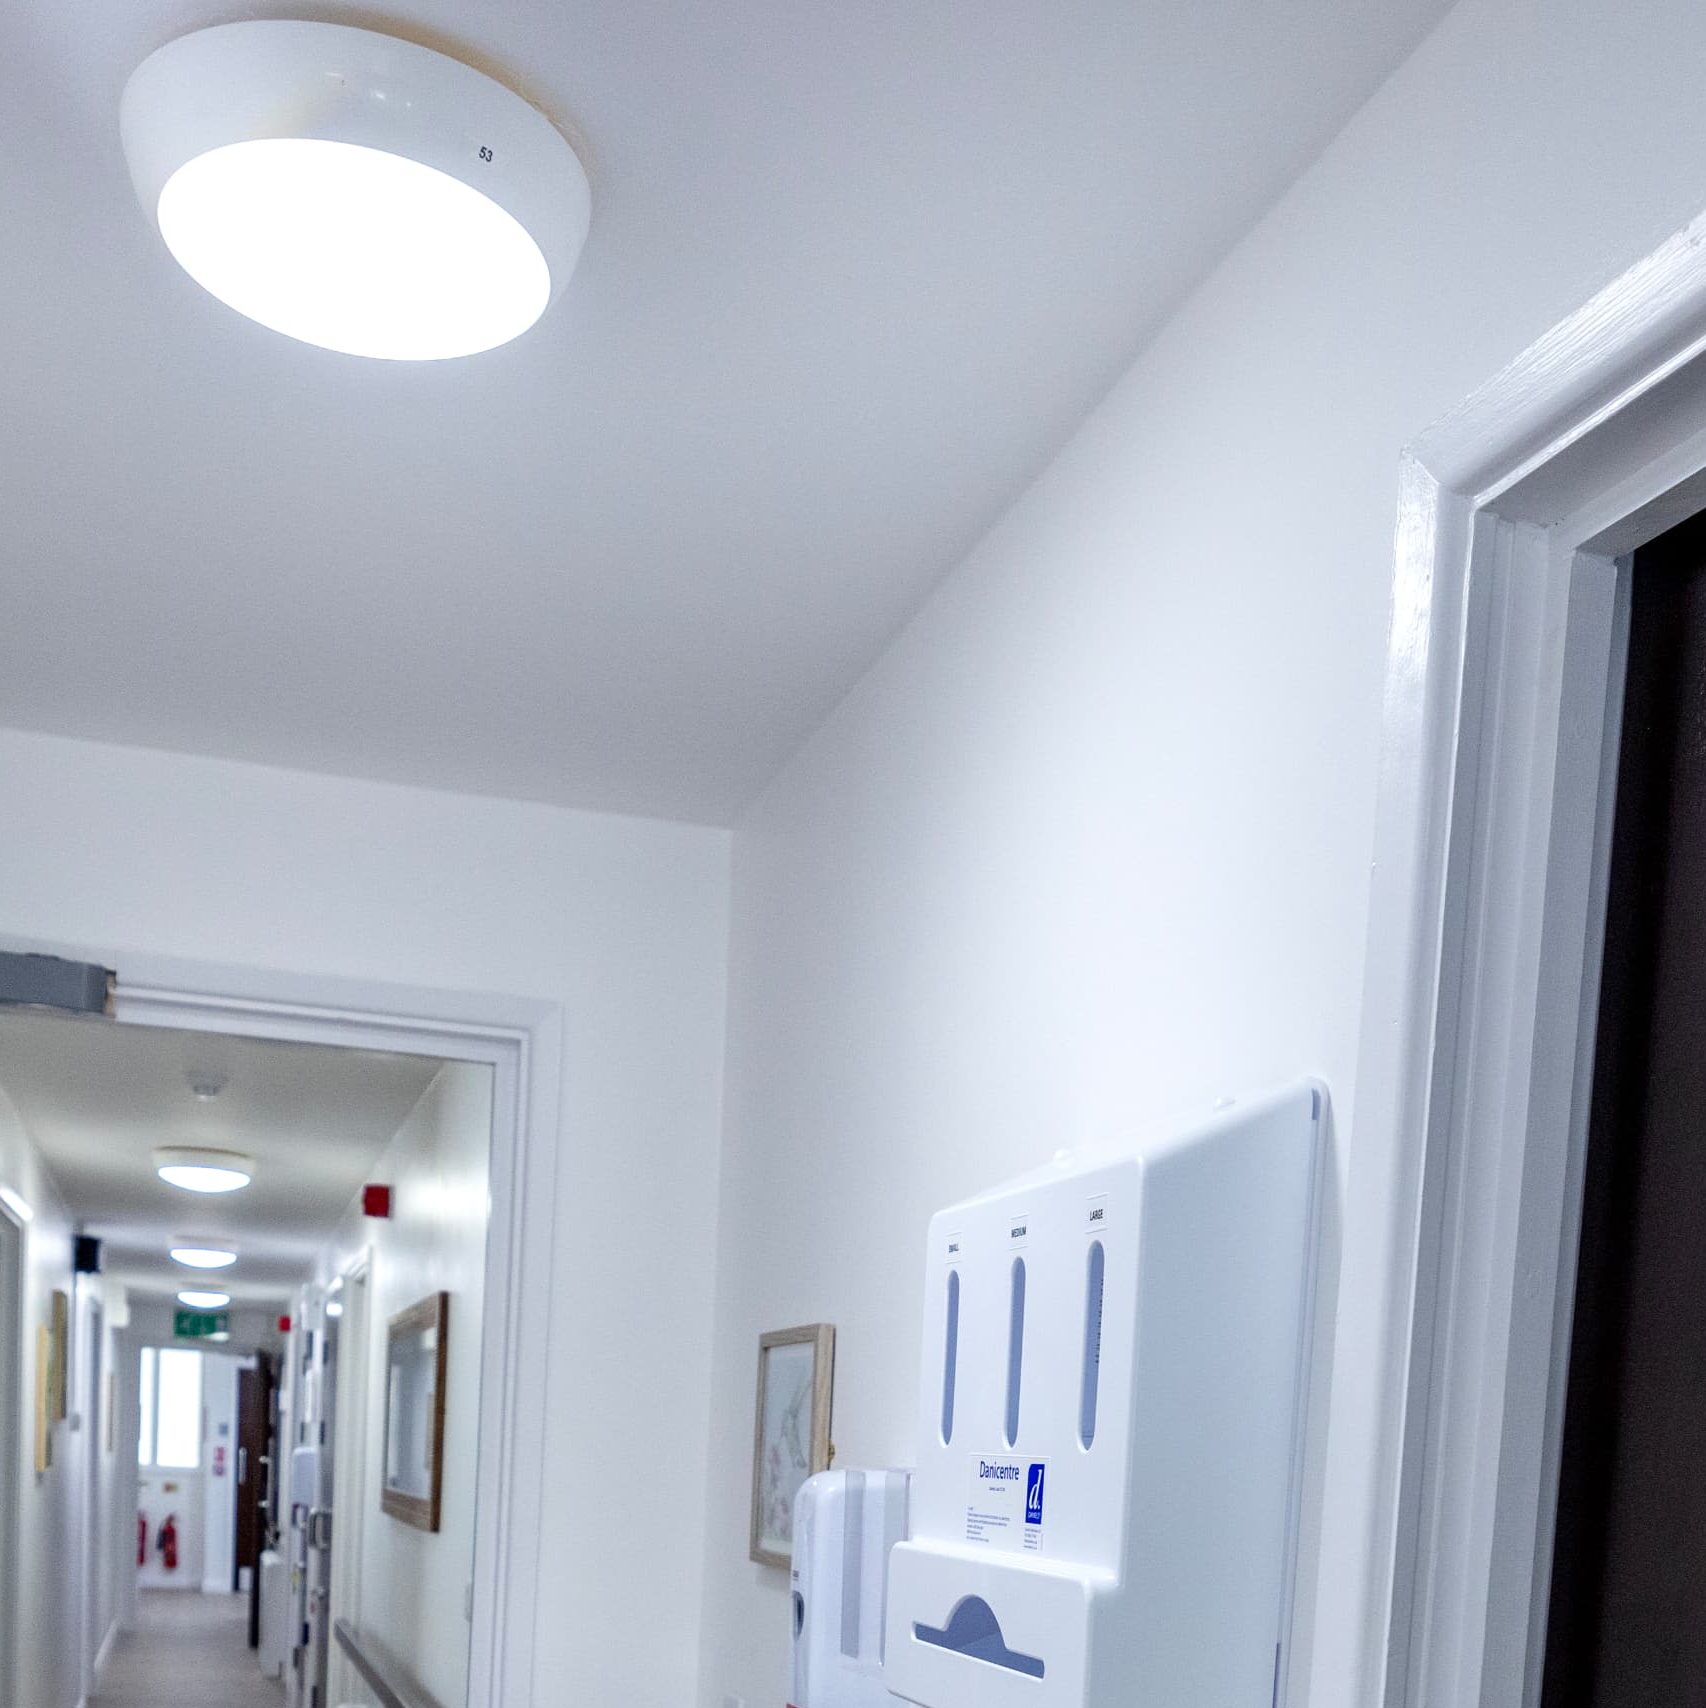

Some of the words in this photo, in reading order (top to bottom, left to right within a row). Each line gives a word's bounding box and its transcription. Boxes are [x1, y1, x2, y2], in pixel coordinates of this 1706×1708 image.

[479, 146, 493, 162] 53
[1089, 1209, 1104, 1222] LARGE
[1011, 1225, 1027, 1239] MEDIUM
[979, 1461, 1020, 1480] Danicentre
